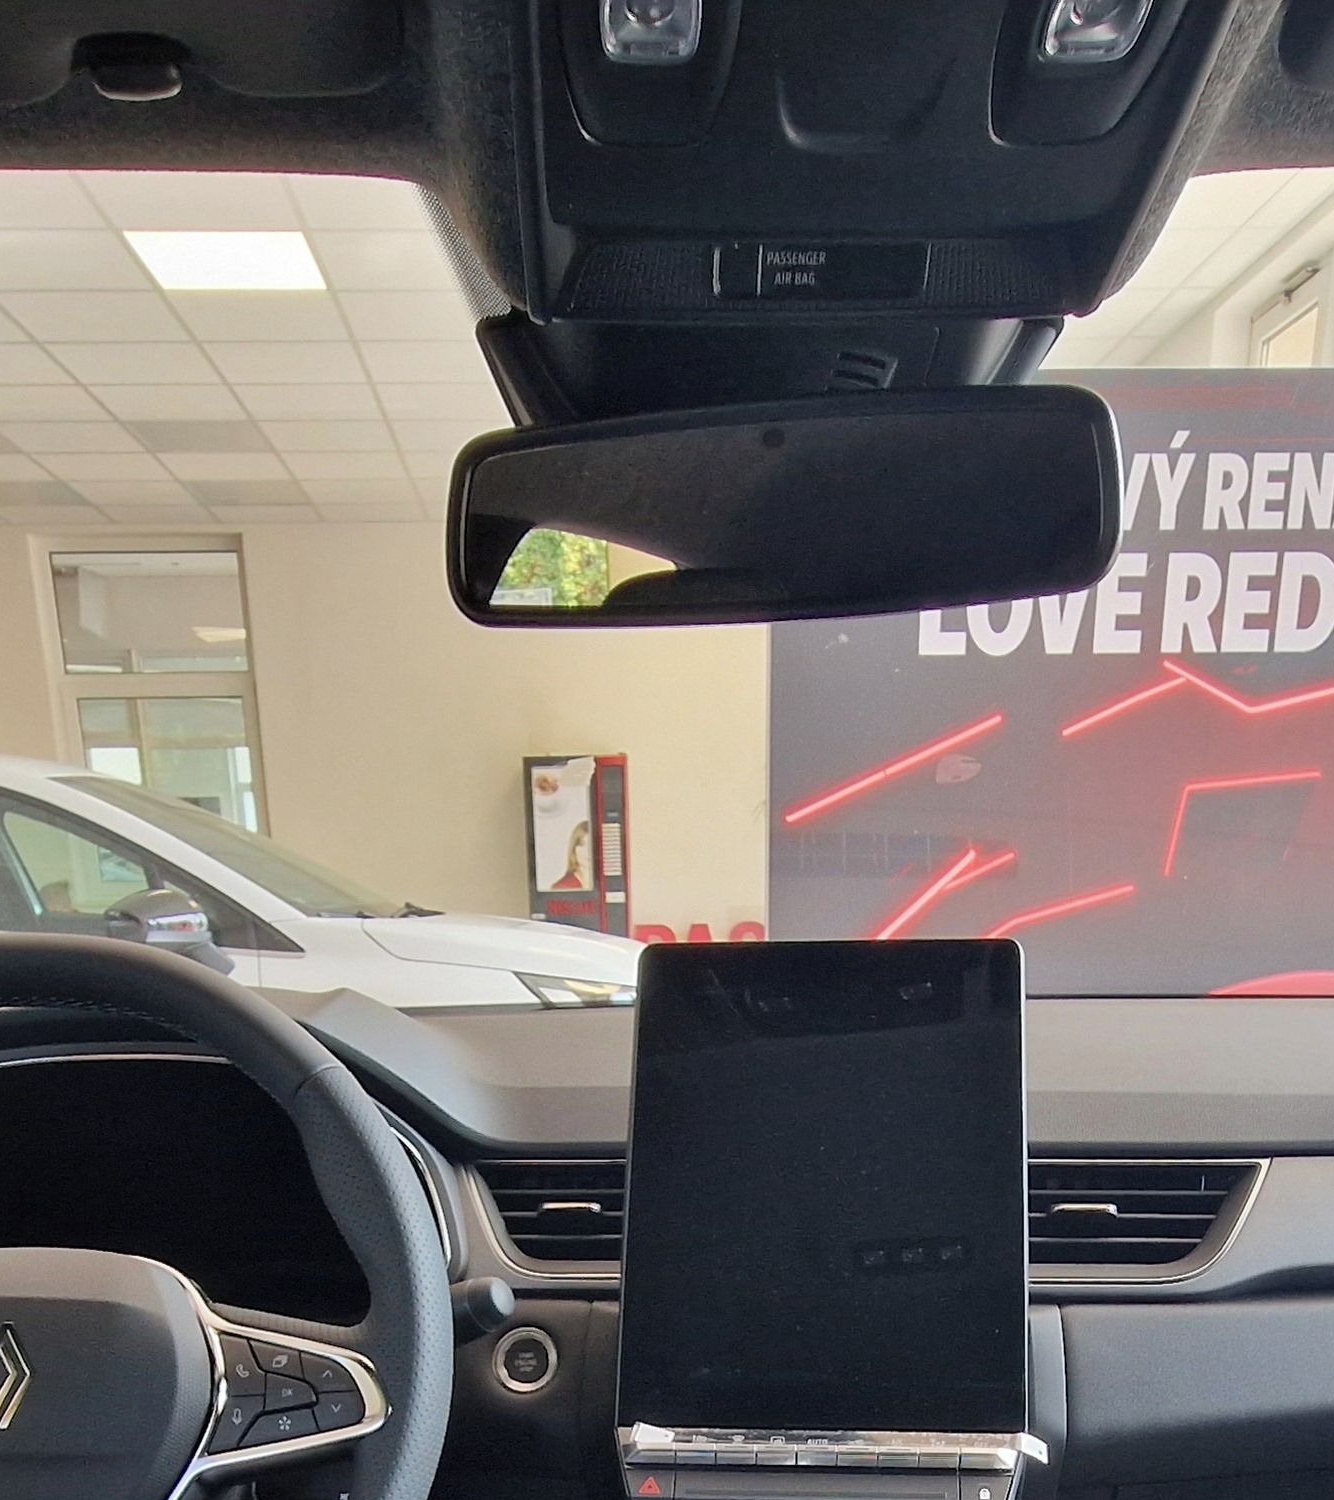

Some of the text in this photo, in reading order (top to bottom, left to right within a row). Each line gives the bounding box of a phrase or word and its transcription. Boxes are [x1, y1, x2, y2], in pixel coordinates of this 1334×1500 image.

[767, 251, 826, 266] PASSENGER
[774, 272, 816, 286] AIR BAG
[1122, 430, 1196, 531] VÝ
